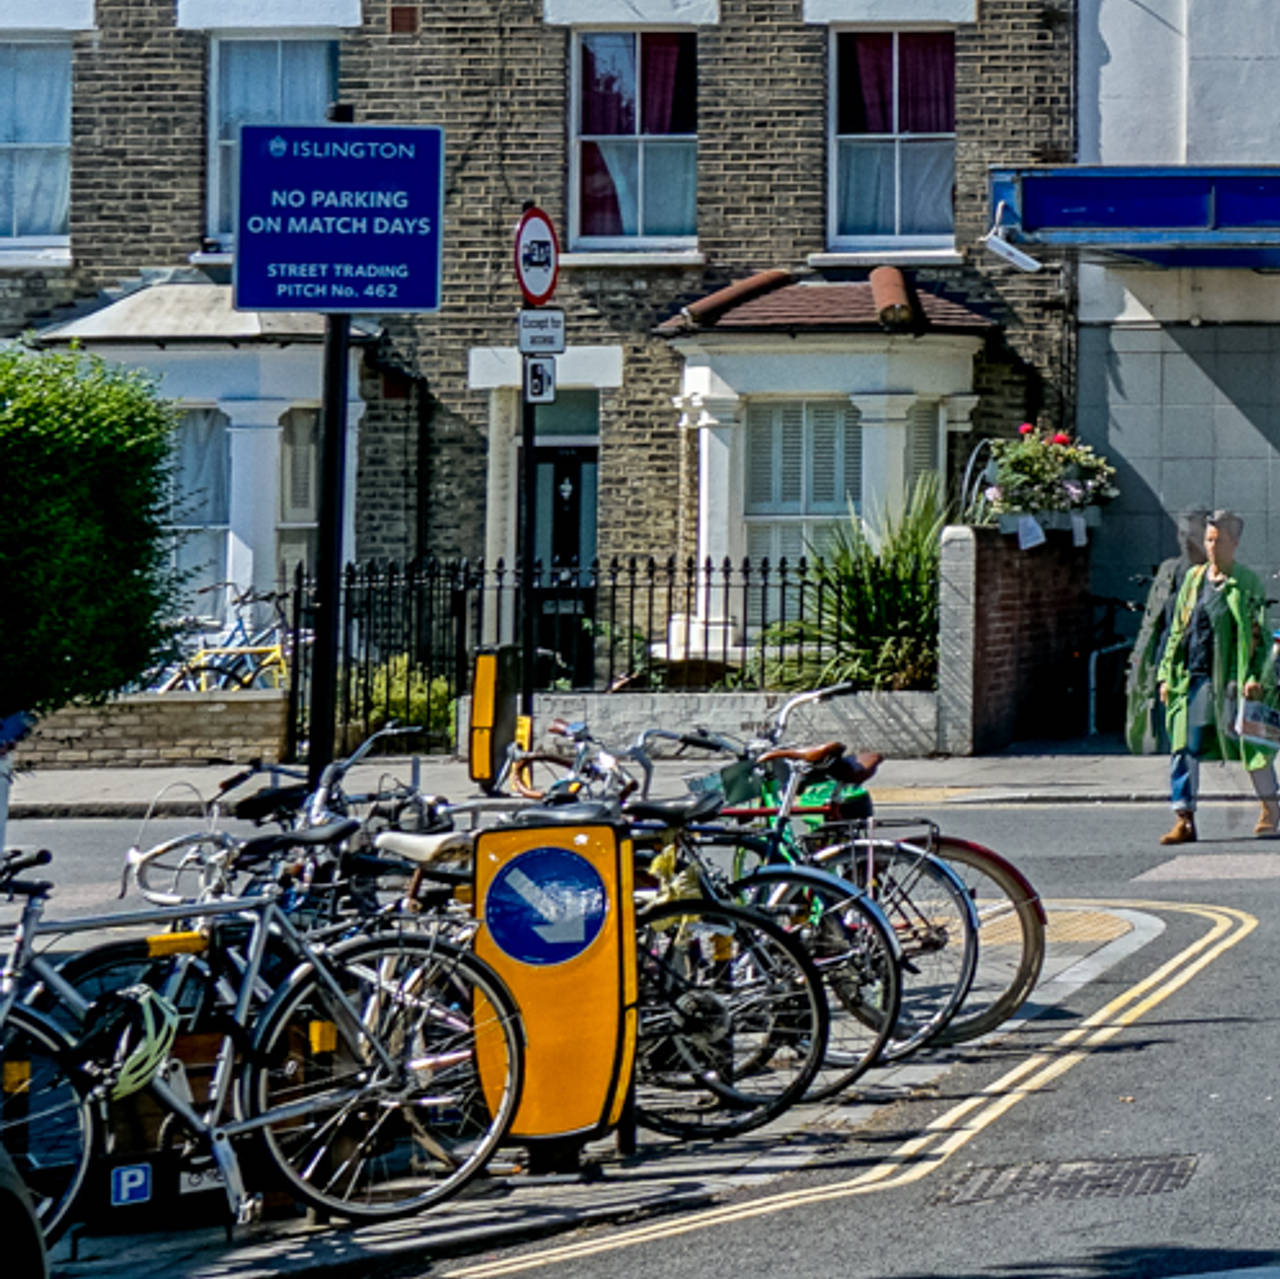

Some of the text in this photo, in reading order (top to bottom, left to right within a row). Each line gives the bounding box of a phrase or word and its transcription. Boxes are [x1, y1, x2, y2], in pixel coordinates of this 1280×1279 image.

[292, 141, 416, 159] ISLINGTON
[271, 190, 409, 209] NO PARKING
[247, 216, 431, 235] ON MATCH DAYS
[267, 263, 410, 278] STREET TRADING
[277, 284, 399, 298] PITCH No. 462
[121, 1168, 145, 1200] P
